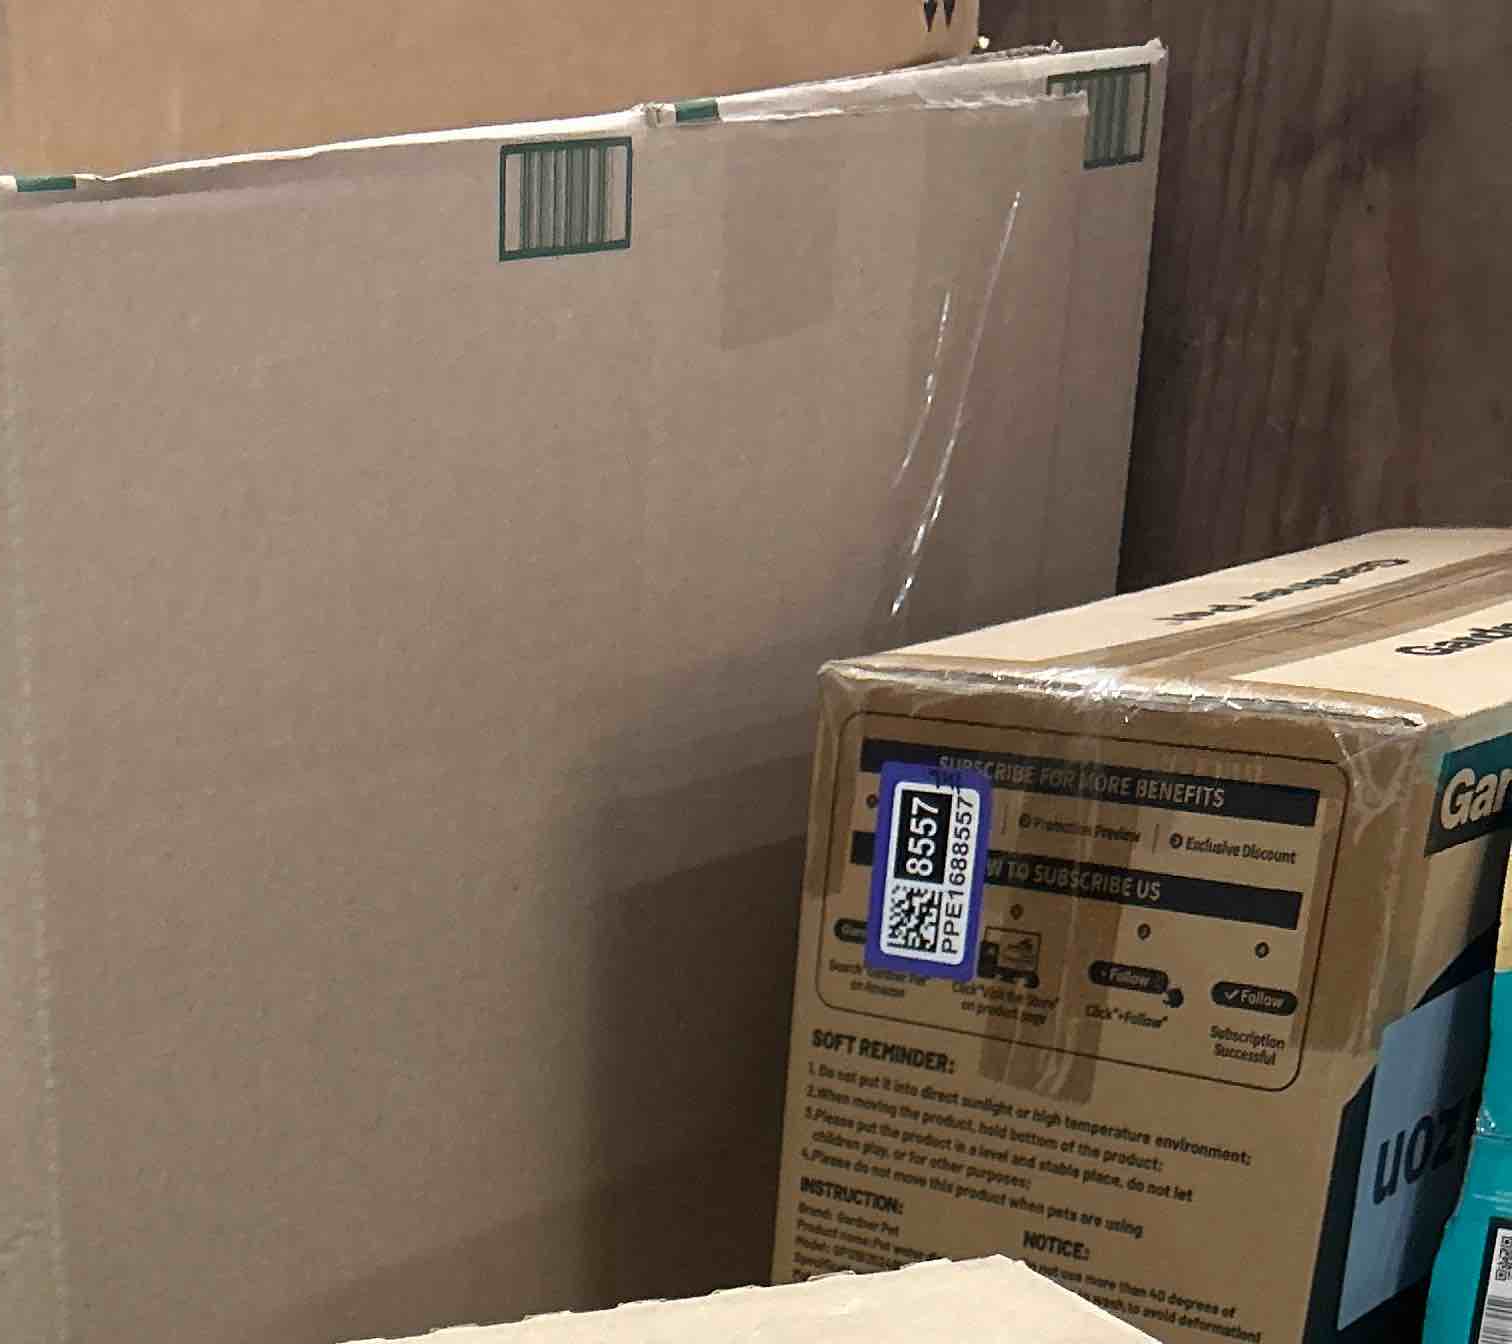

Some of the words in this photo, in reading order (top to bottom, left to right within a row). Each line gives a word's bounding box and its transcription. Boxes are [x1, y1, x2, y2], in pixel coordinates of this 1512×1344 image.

[1039, 767, 1076, 790] FOR
[1079, 770, 1133, 797] MORE
[1136, 778, 1225, 808] BENEFITS
[906, 796, 939, 877] 8557
[1186, 837, 1241, 857] Exclusive
[1243, 843, 1296, 864] Discount
[942, 792, 974, 955] PPE1688557
[1035, 864, 1133, 896] SUBSCRIBE
[1138, 880, 1161, 901] US
[1240, 990, 1286, 1009] Follow
[811, 1029, 856, 1054] SOFT
[858, 1037, 956, 1075] REMINDER:
[1209, 1025, 1286, 1051] Subscription
[1213, 1043, 1277, 1066] Successful
[920, 1084, 958, 1104] direct
[1032, 1107, 1061, 1129] high
[1065, 1115, 1150, 1147] temperature
[1009, 1128, 1058, 1150] bottom
[800, 1175, 904, 1215] INSTRUCTION:
[1127, 1176, 1144, 1192] do
[1146, 1182, 1171, 1197] not
[1173, 1186, 1192, 1202] let
[1046, 1203, 1078, 1222] pets
[1080, 1211, 1102, 1227] are
[1104, 1219, 1144, 1239] using
[1023, 1230, 1089, 1261] NOTICE:
[1085, 1275, 1116, 1289] more
[1119, 1281, 1146, 1296] than
[1168, 1292, 1219, 1315] degrees
[1143, 1306, 1176, 1323] avoid
